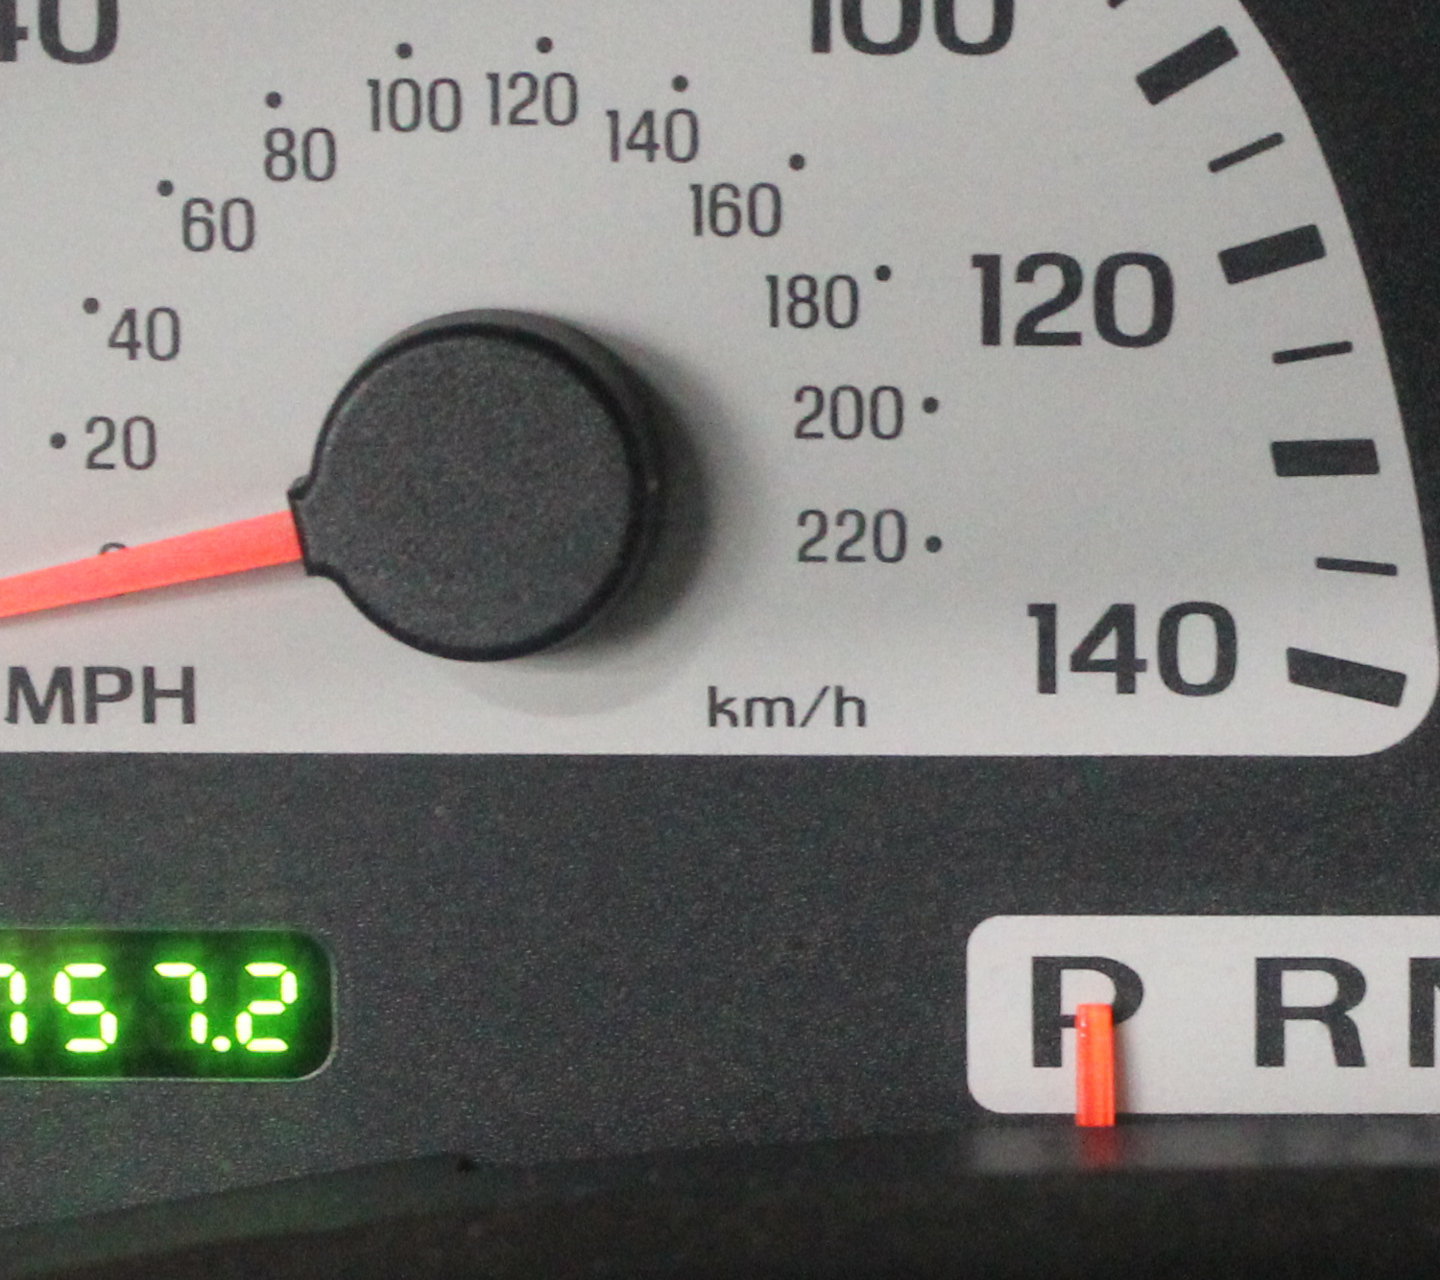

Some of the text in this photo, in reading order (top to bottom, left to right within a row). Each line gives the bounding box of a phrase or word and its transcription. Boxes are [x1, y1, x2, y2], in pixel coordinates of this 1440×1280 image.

[367, 78, 462, 132] 100
[487, 72, 578, 126] 120
[264, 127, 336, 182] 80
[606, 108, 699, 163] 140
[182, 197, 255, 252] 60
[690, 183, 782, 237] 160
[766, 274, 859, 329] 180
[972, 252, 1174, 348] 120
[108, 307, 180, 361] 40
[795, 385, 904, 440] 200
[86, 416, 156, 470] 20
[798, 509, 907, 563] 220
[1028, 601, 1237, 696] 140
[5, 666, 195, 724] MPH
[708, 686, 866, 727] km/h
[1032, 956, 1144, 1067] P
